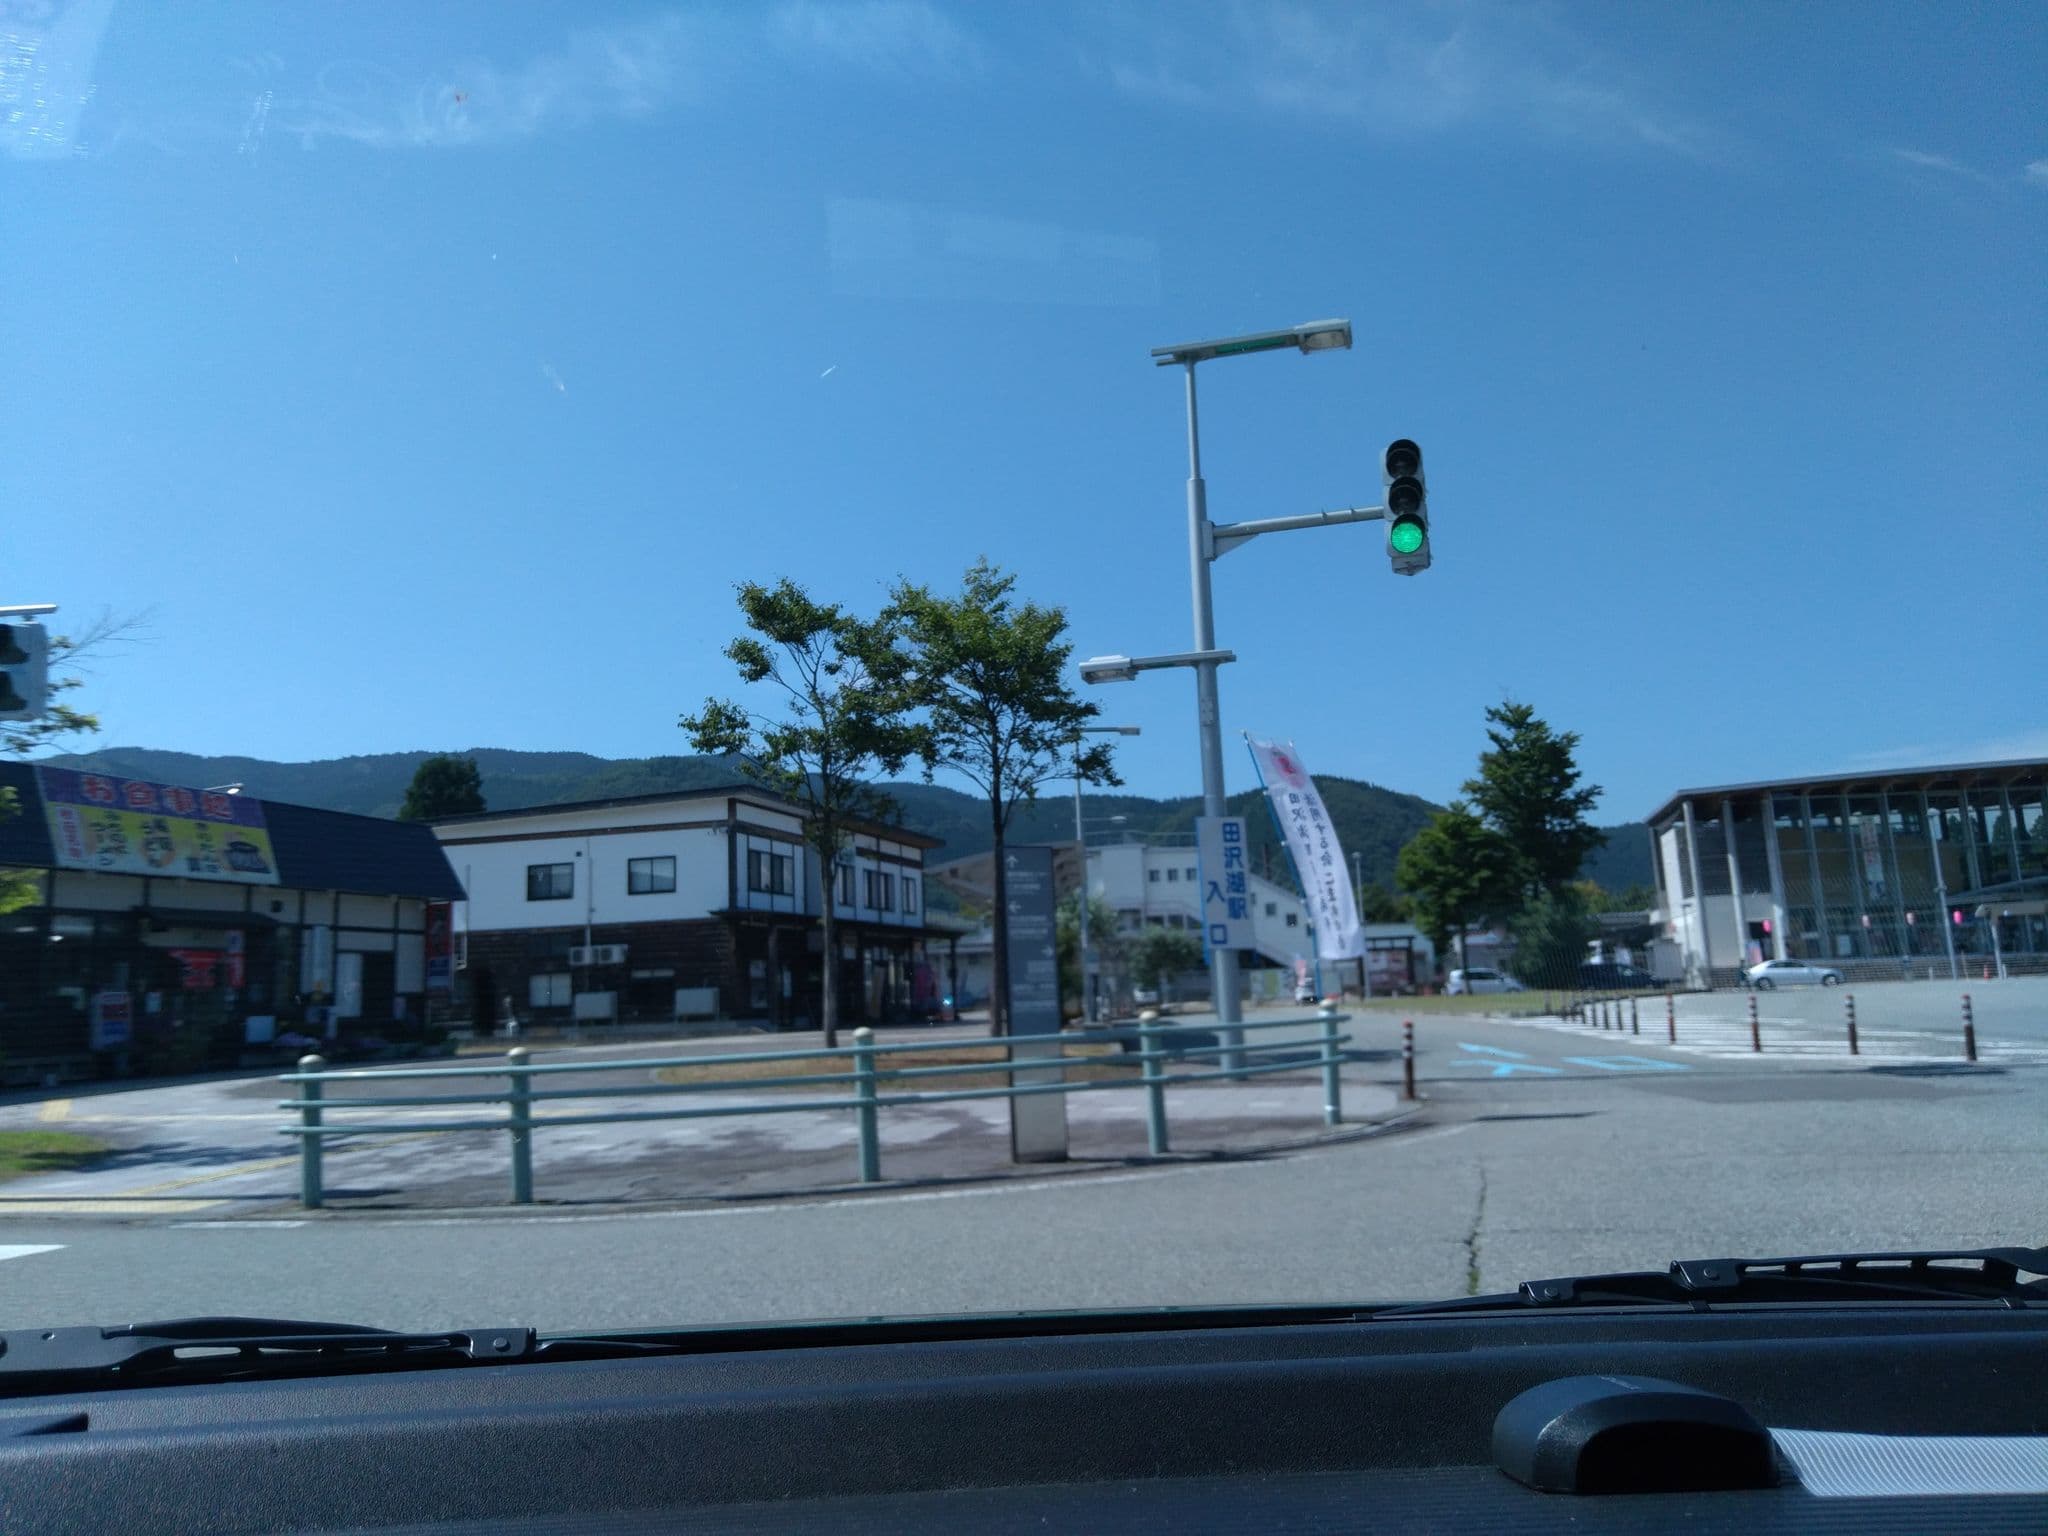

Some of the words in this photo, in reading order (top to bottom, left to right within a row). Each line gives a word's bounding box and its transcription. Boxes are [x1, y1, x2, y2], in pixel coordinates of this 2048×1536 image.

[1222, 822, 1249, 920] 田沢湖駅
[1206, 880, 1228, 945] 入口
